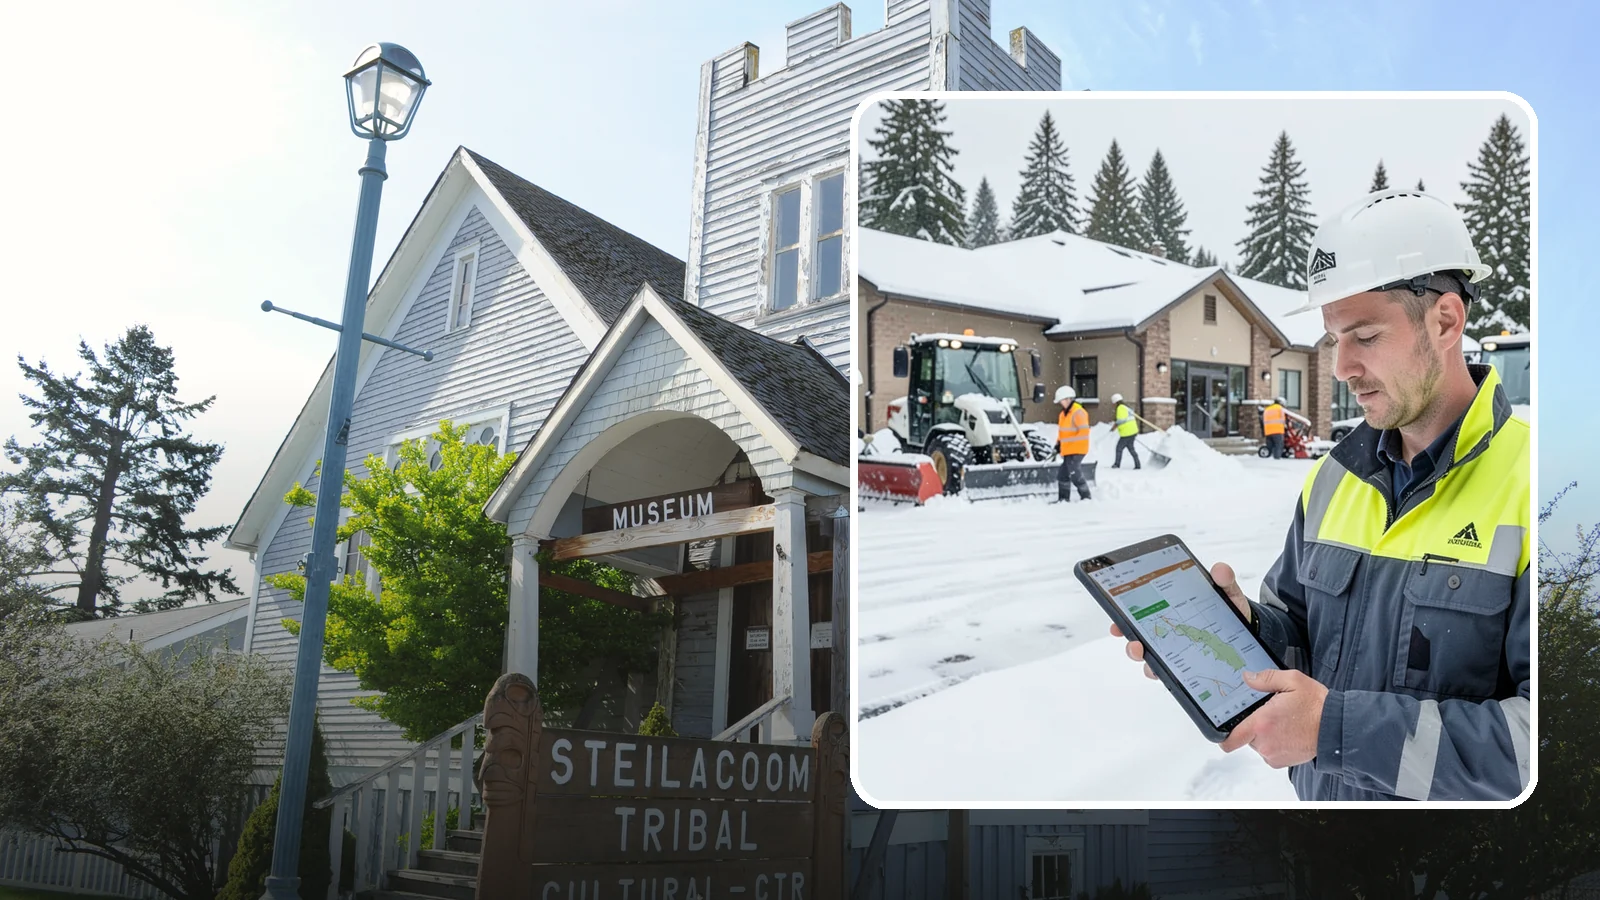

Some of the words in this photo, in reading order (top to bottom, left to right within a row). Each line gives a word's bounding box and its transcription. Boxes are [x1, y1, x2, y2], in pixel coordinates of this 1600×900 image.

[613, 491, 714, 531] MUSEUM
[550, 738, 810, 793] STEILACOOM
[614, 806, 758, 852] TRIBAL
